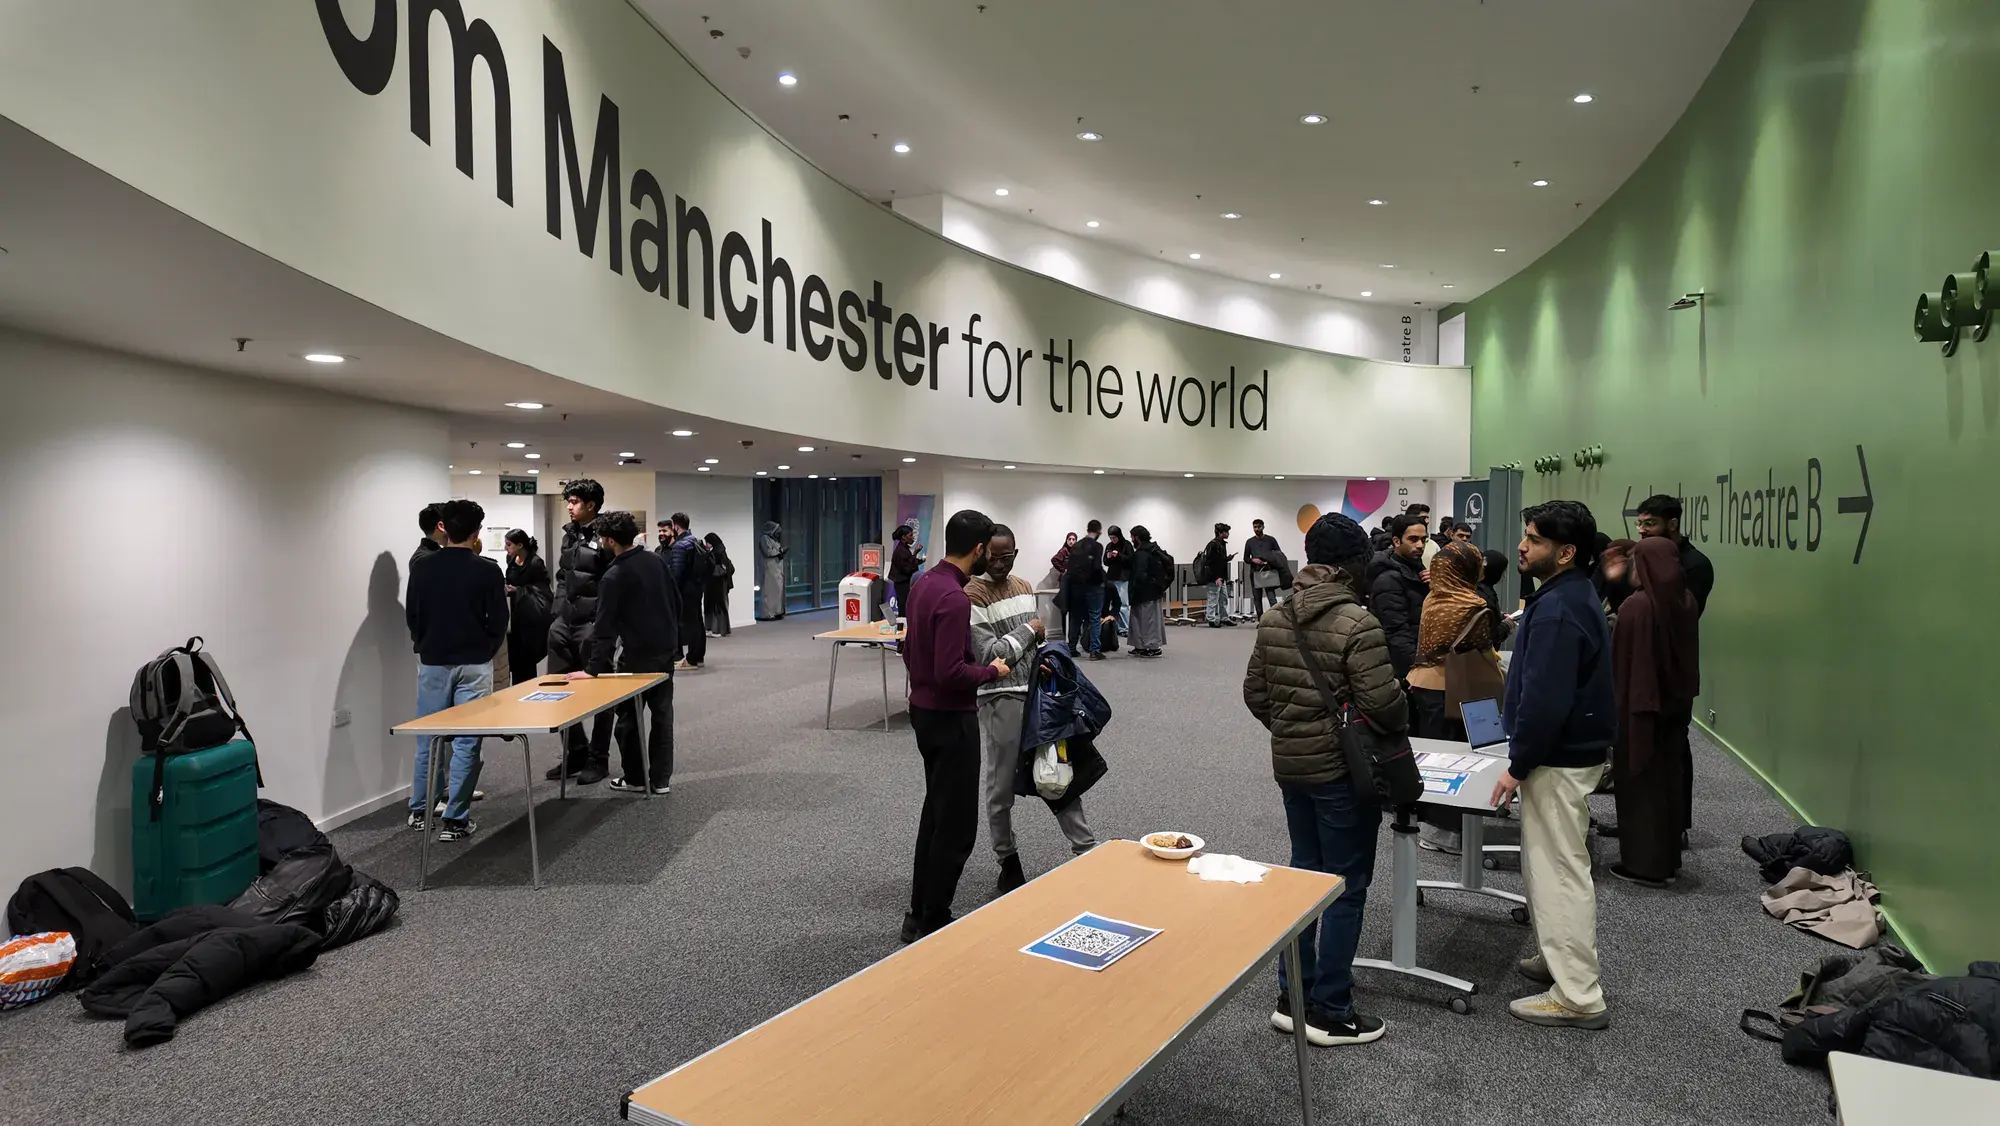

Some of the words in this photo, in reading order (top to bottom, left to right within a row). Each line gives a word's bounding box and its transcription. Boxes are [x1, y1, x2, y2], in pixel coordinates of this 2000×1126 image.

[543, 34, 949, 390] Manchester
[962, 314, 1032, 406] for
[1043, 338, 1123, 419] the
[1137, 366, 1269, 431] world
[1401, 315, 1412, 324] B
[1398, 487, 1408, 496] B
[1717, 467, 1799, 550] Theatre
[1806, 457, 1822, 552] B
